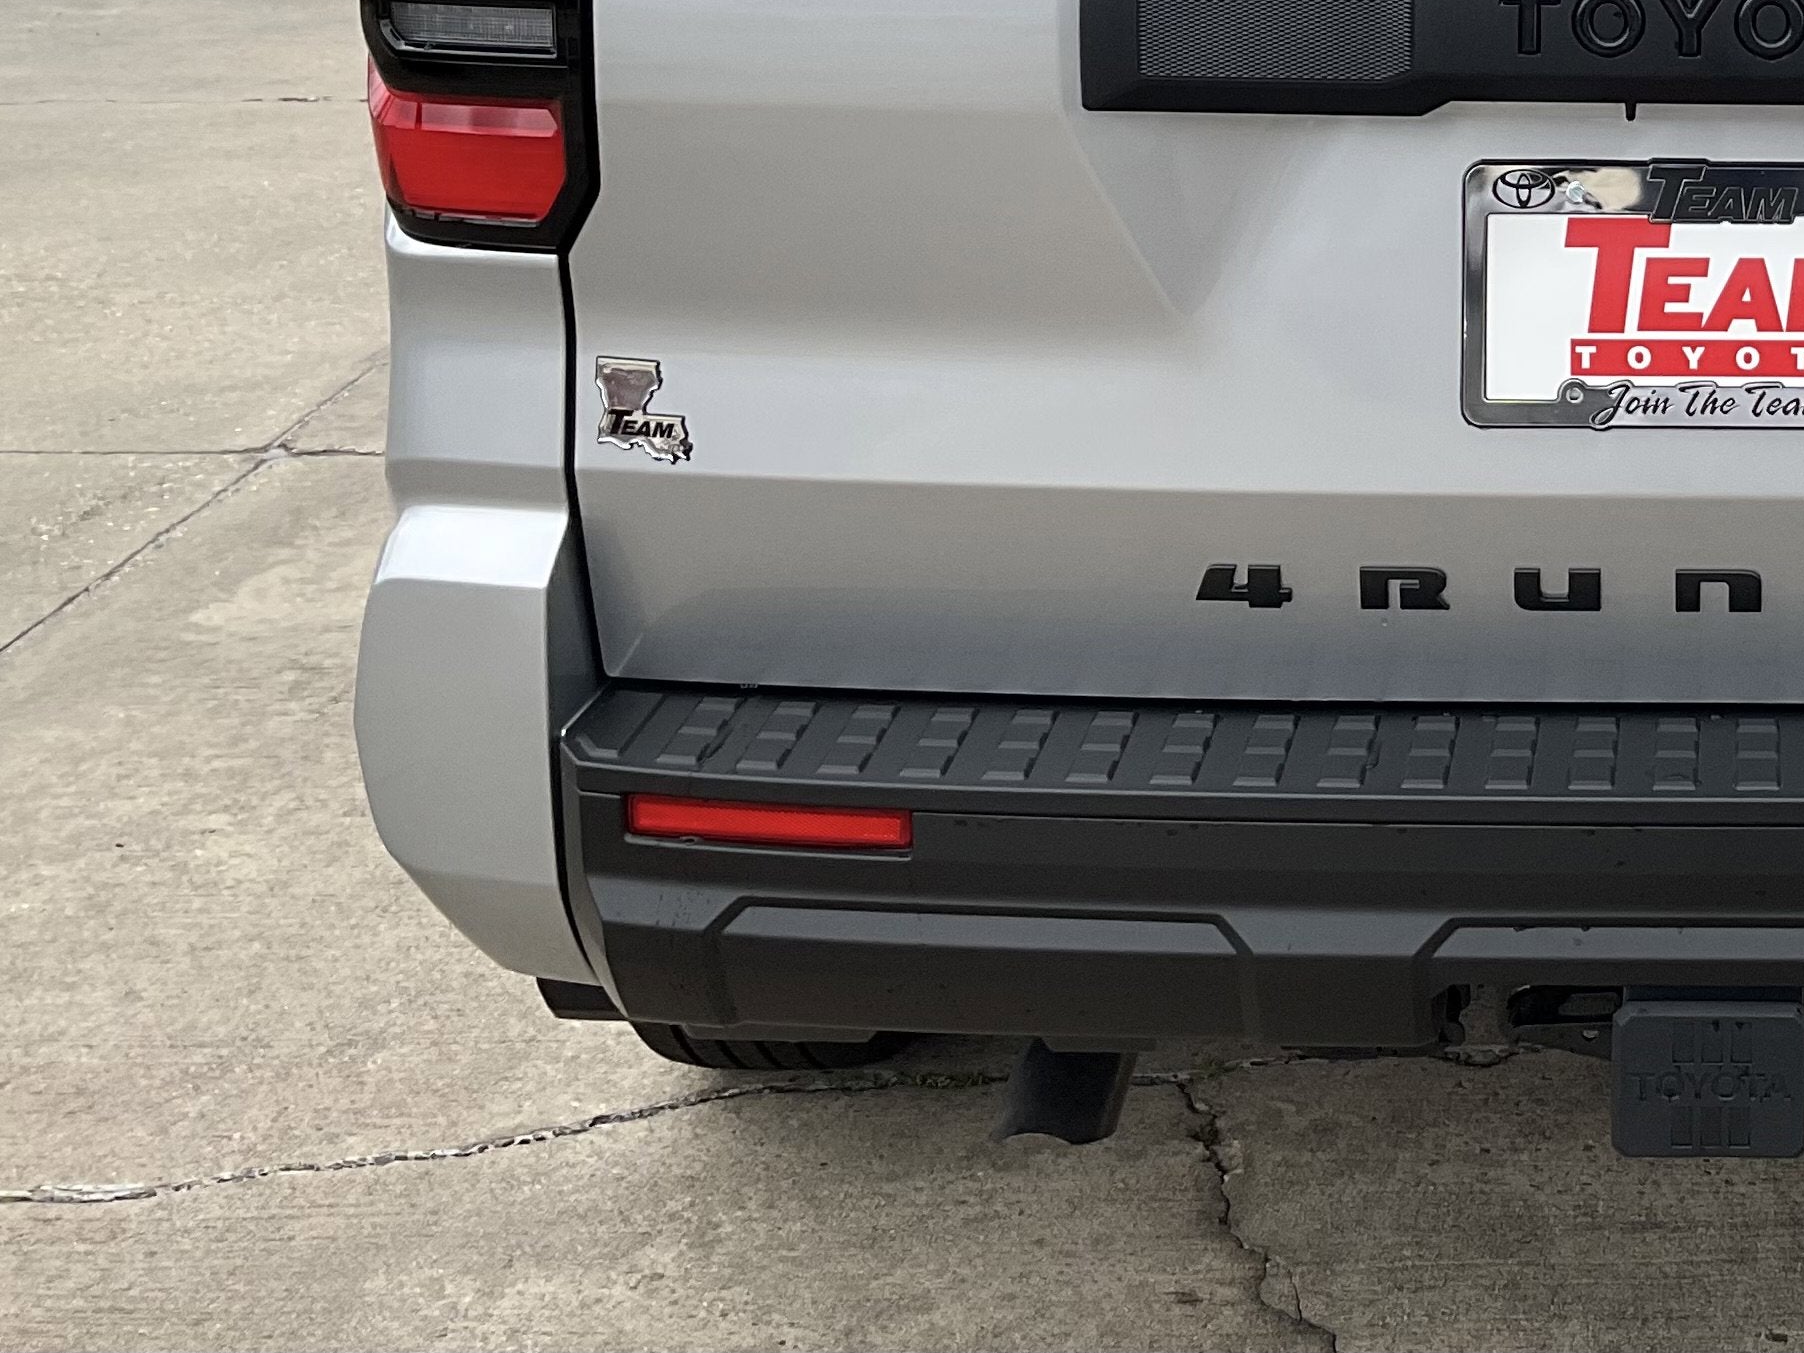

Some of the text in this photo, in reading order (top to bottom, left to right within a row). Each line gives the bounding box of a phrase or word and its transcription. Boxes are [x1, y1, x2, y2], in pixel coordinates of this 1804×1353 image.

[1644, 164, 1799, 224] TEAM
[608, 408, 674, 438] TEAM
[1590, 383, 1673, 426] Join
[1678, 384, 1740, 418] The
